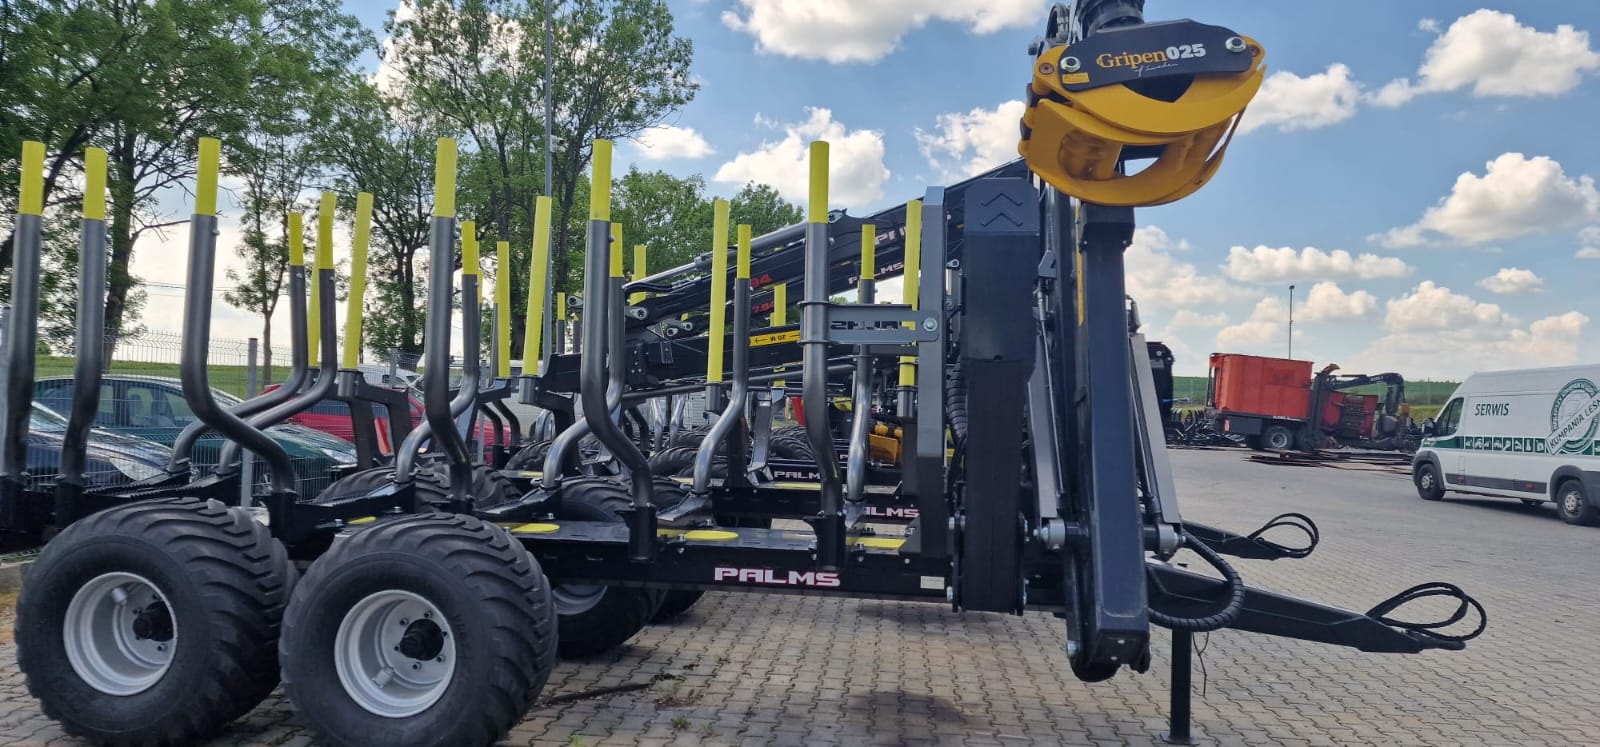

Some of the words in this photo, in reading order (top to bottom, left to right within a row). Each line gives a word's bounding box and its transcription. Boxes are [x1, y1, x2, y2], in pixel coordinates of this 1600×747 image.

[1474, 403, 1509, 416] SERWIS
[1549, 414, 1585, 449] KOMPANIA
[773, 471, 821, 479] PALM
[714, 567, 840, 588] PALMS
